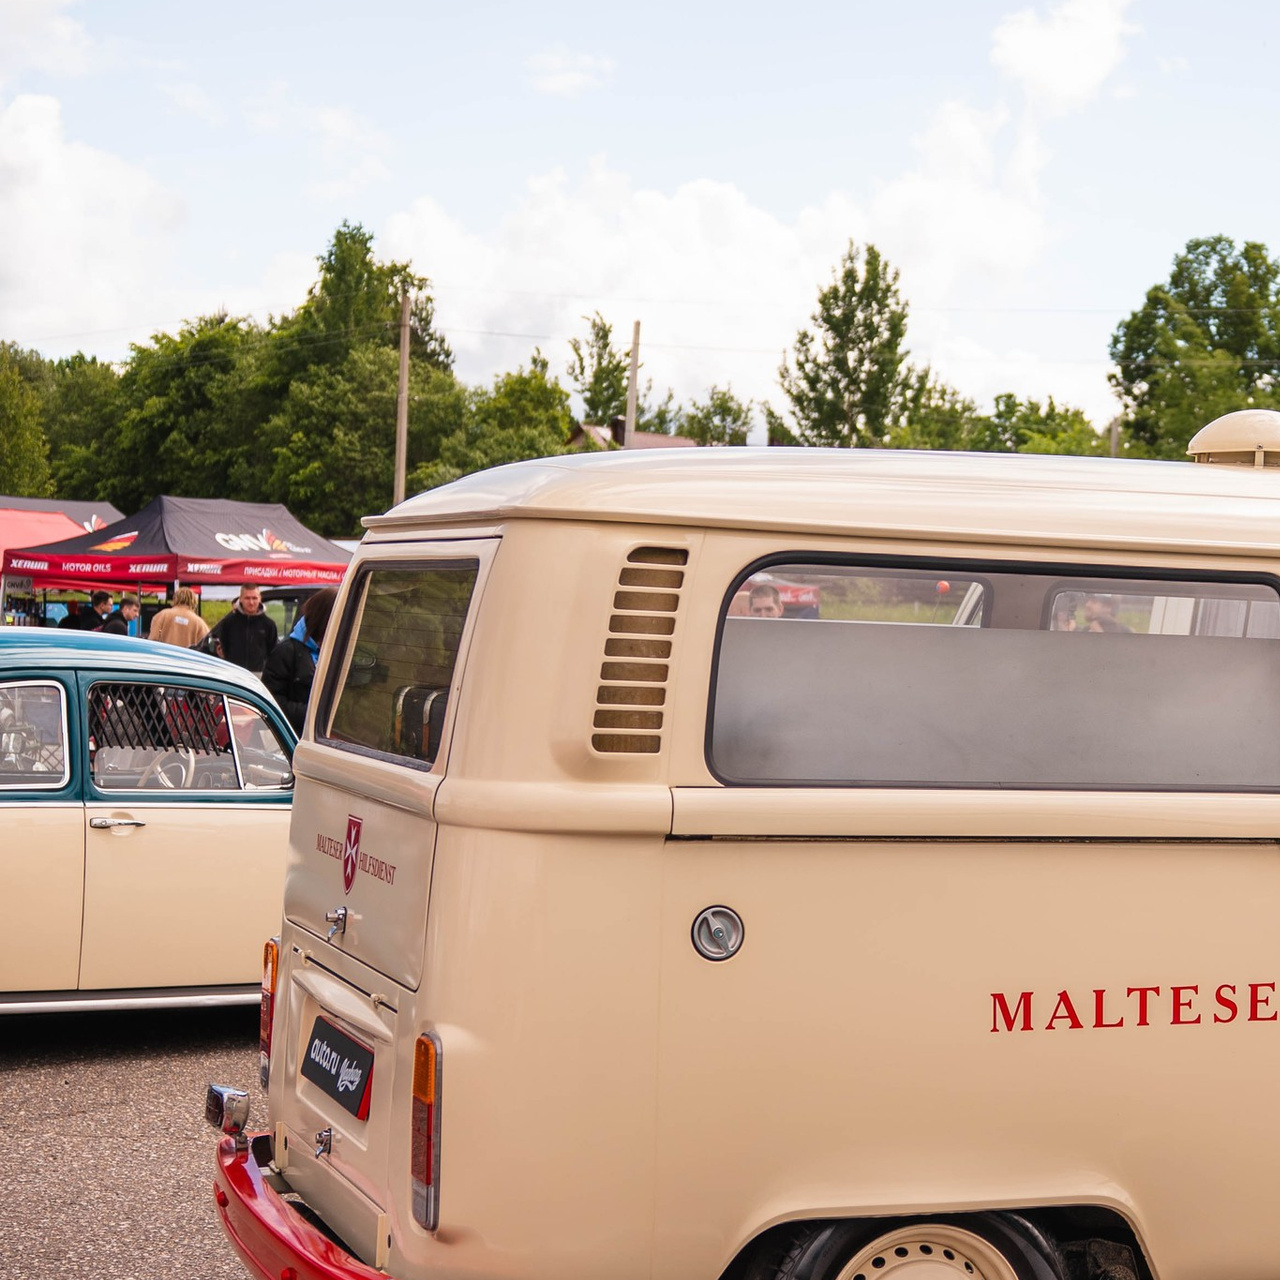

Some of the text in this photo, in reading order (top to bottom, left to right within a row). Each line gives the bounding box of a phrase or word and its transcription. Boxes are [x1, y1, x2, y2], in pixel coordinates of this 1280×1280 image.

[62, 562, 111, 573] MOTOR OILS
[316, 833, 343, 861] MALTESER
[359, 851, 397, 885] HILFSDIENST
[310, 1038, 341, 1076] auto.ru
